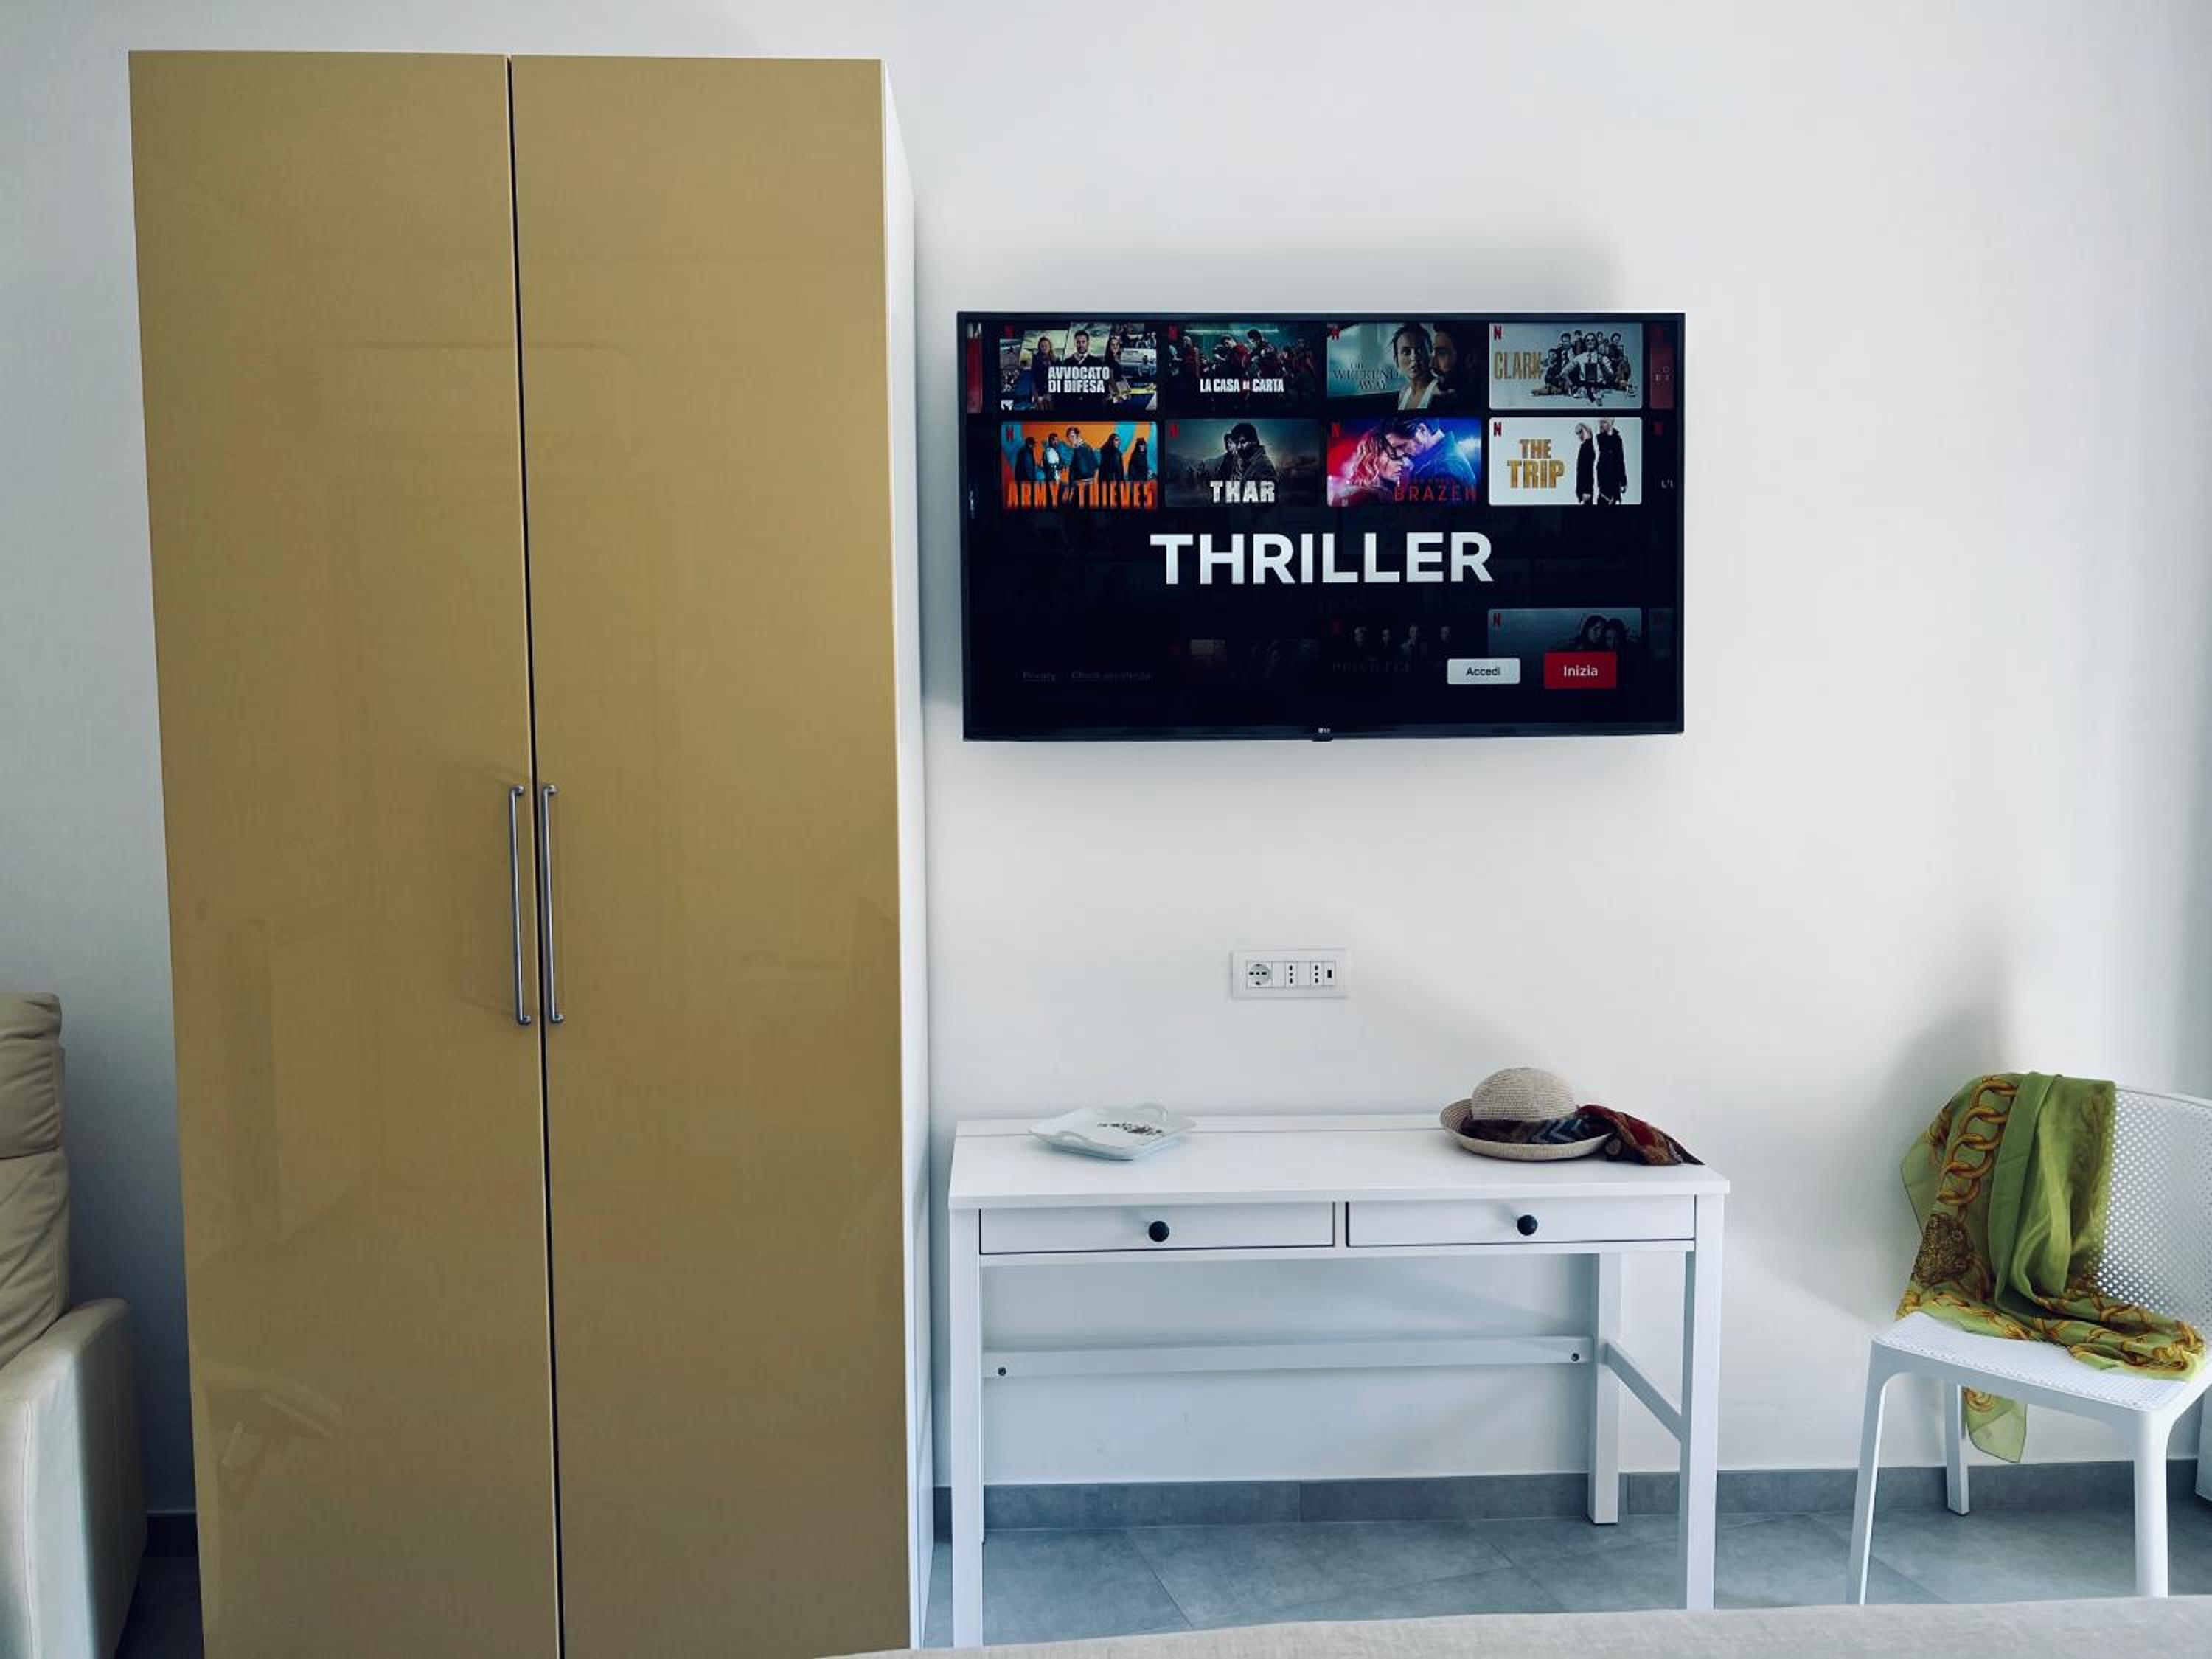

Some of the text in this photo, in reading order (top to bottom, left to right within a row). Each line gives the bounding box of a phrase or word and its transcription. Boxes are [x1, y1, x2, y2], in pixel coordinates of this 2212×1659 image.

[1494, 325, 1502, 339] N
[1494, 352, 1543, 379] CLARK
[1048, 366, 1110, 380] AVVOCATO
[1332, 369, 1400, 380] WEEKEND
[1048, 380, 1105, 393] DI DIFESA
[1200, 379, 1212, 392] LA
[1213, 379, 1240, 392] CASA
[1253, 379, 1284, 392] CARTA
[1357, 380, 1387, 390] AWAY
[1494, 422, 1502, 437] N
[1519, 439, 1551, 459] THE
[1507, 459, 1565, 489] TRIP
[1007, 481, 1060, 508] ARMY
[1077, 481, 1155, 508] THIEVES
[1210, 480, 1275, 503] THAR
[1394, 485, 1478, 502] BRAZEN
[1150, 532, 1493, 585] THRILLER
[1466, 666, 1501, 677] Accedi
[1563, 665, 1599, 678] Inizia
